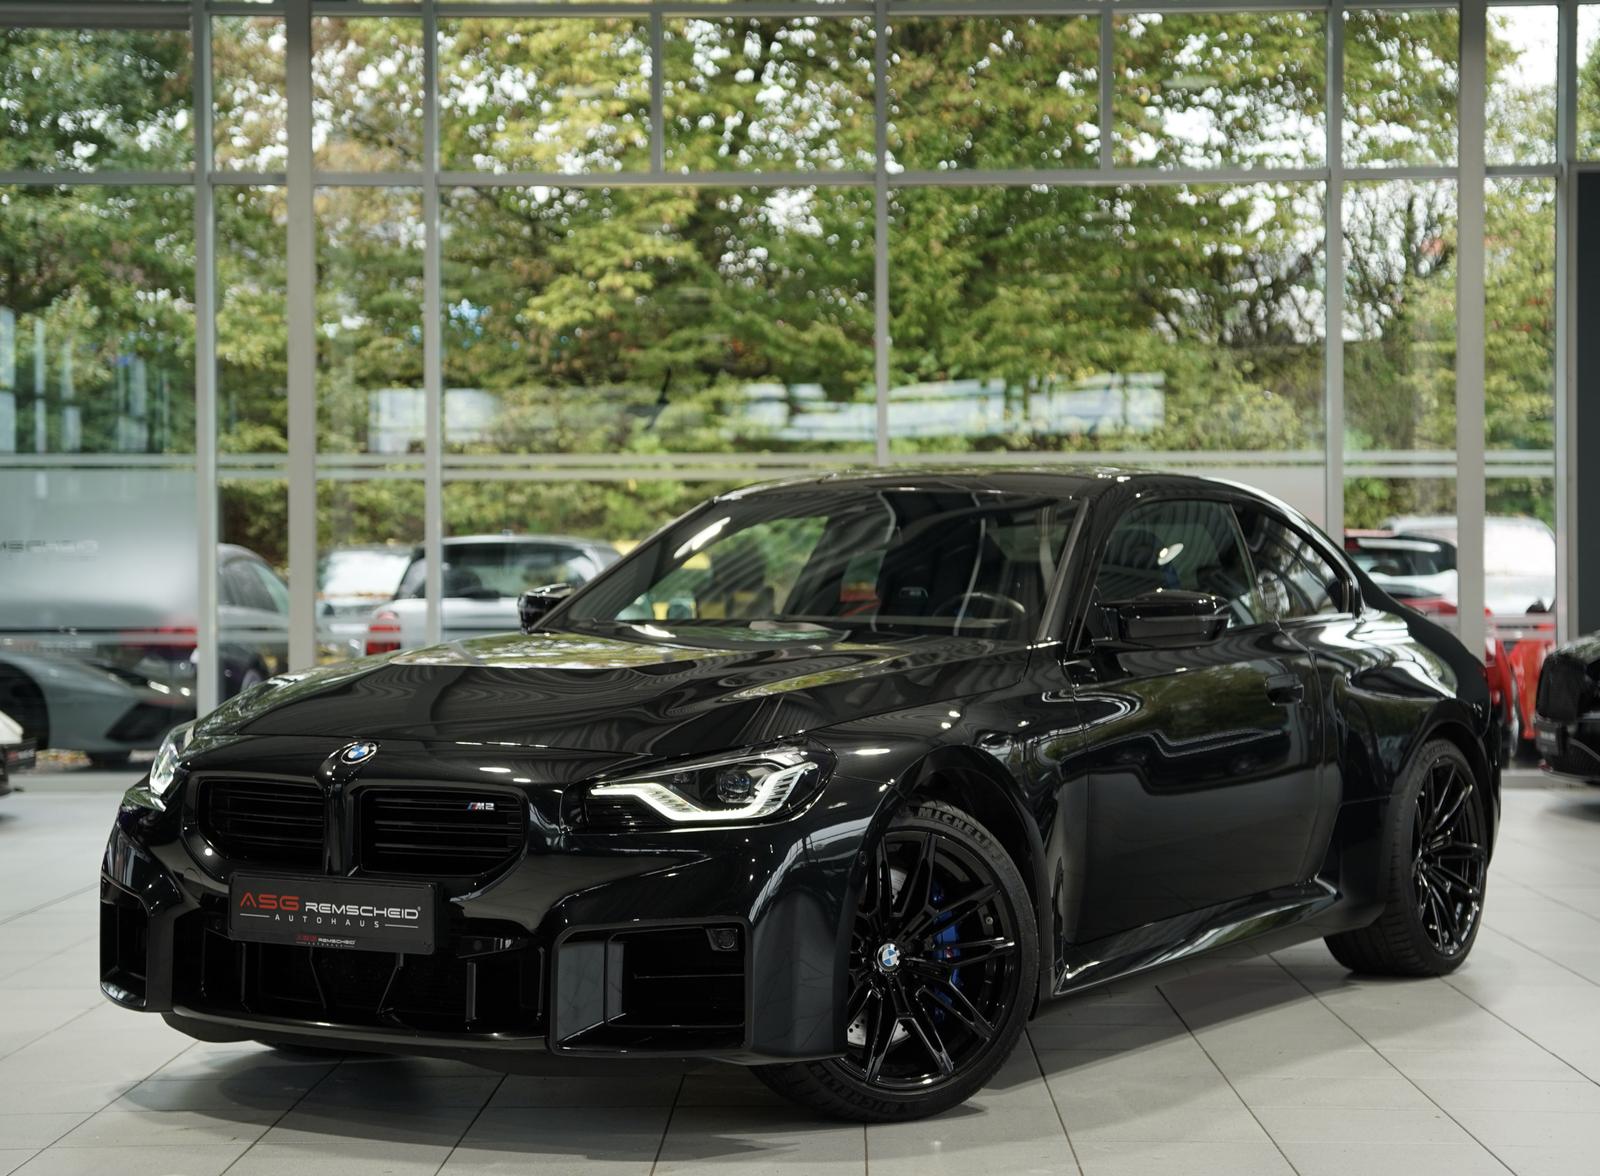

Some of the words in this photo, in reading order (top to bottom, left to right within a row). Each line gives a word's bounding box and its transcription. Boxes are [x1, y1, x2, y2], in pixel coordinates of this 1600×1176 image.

[470, 802, 495, 810] M2
[240, 891, 299, 911] ASG
[305, 902, 419, 920] REMSCHEID
[274, 913, 380, 928] AUTOHAUS
